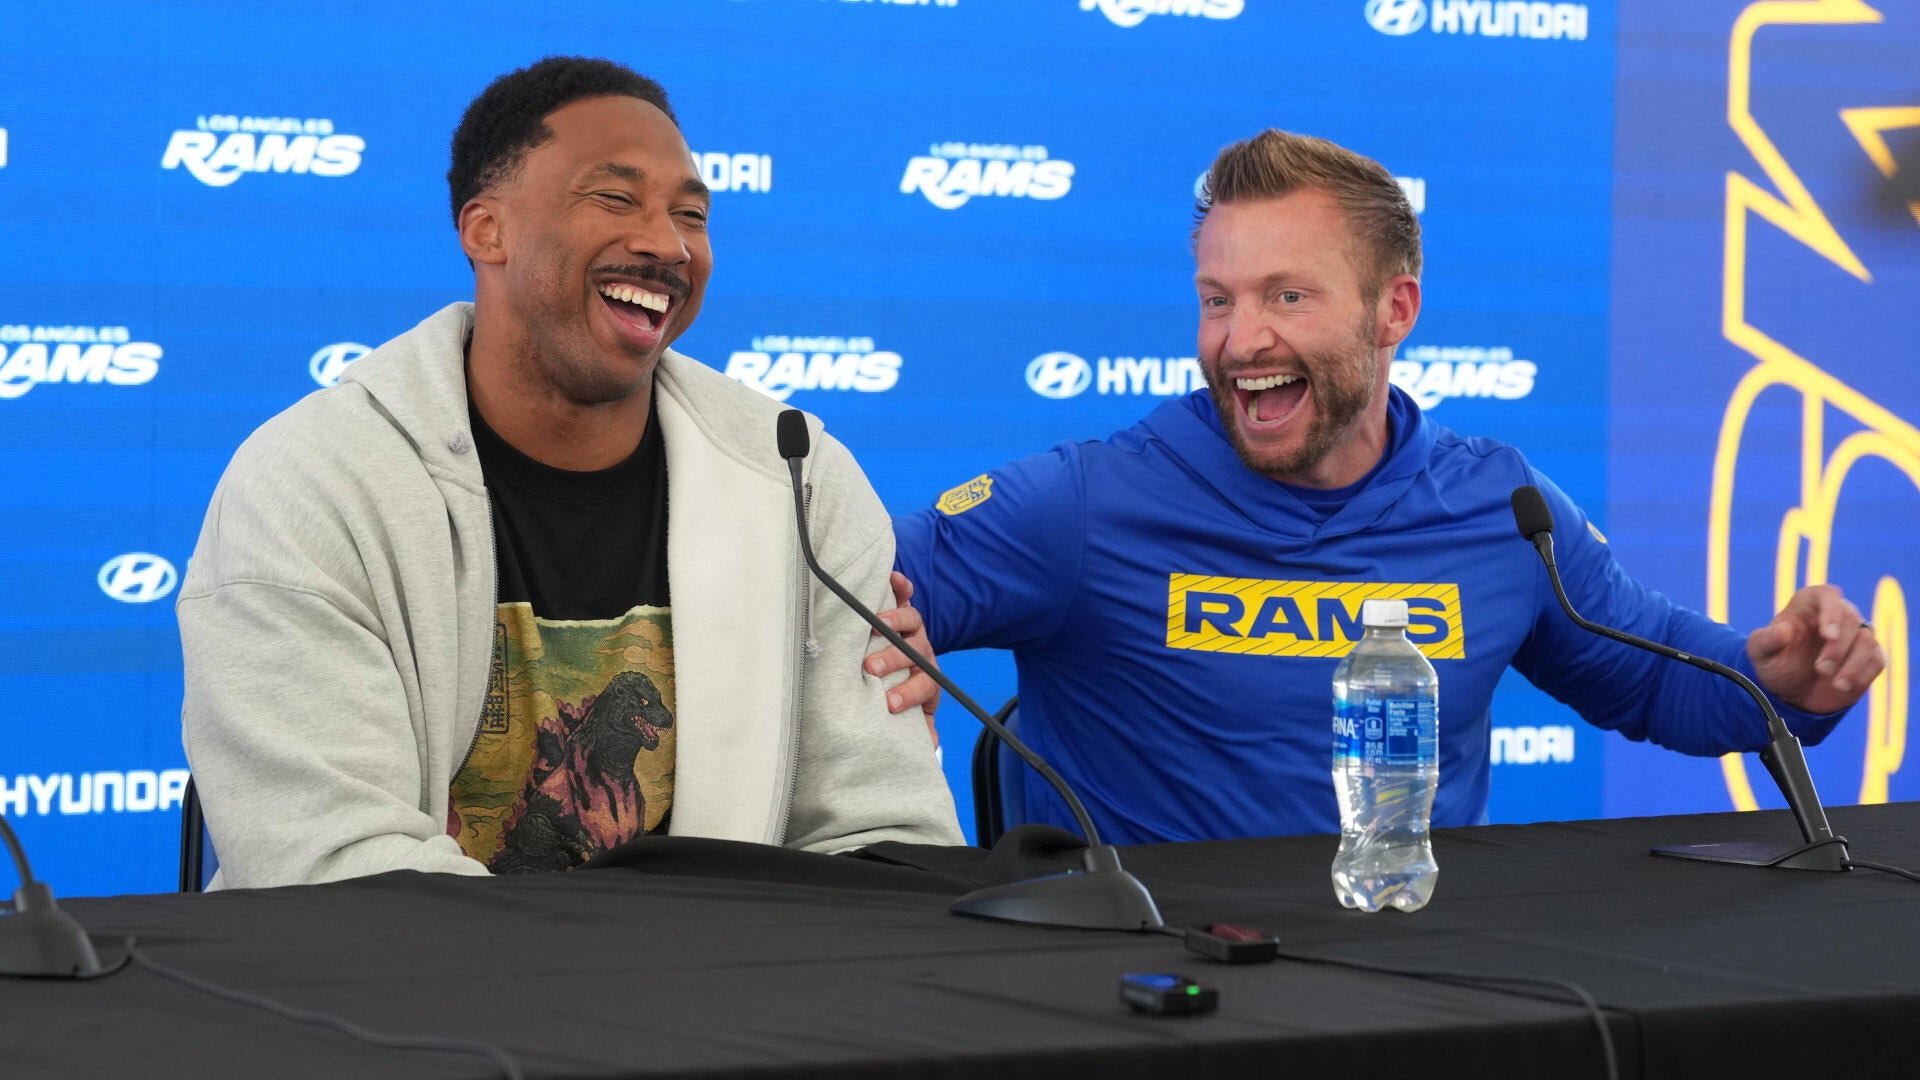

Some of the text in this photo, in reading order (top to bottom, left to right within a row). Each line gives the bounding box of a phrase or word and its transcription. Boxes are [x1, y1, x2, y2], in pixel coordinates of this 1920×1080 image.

[1431, 0, 1588, 41] HYUNDAI
[161, 129, 366, 187] RAMS
[899, 156, 1076, 210] RAMS
[724, 350, 904, 402] RAMS
[1388, 359, 1539, 411] RAMS
[1184, 590, 1450, 645] RAMS
